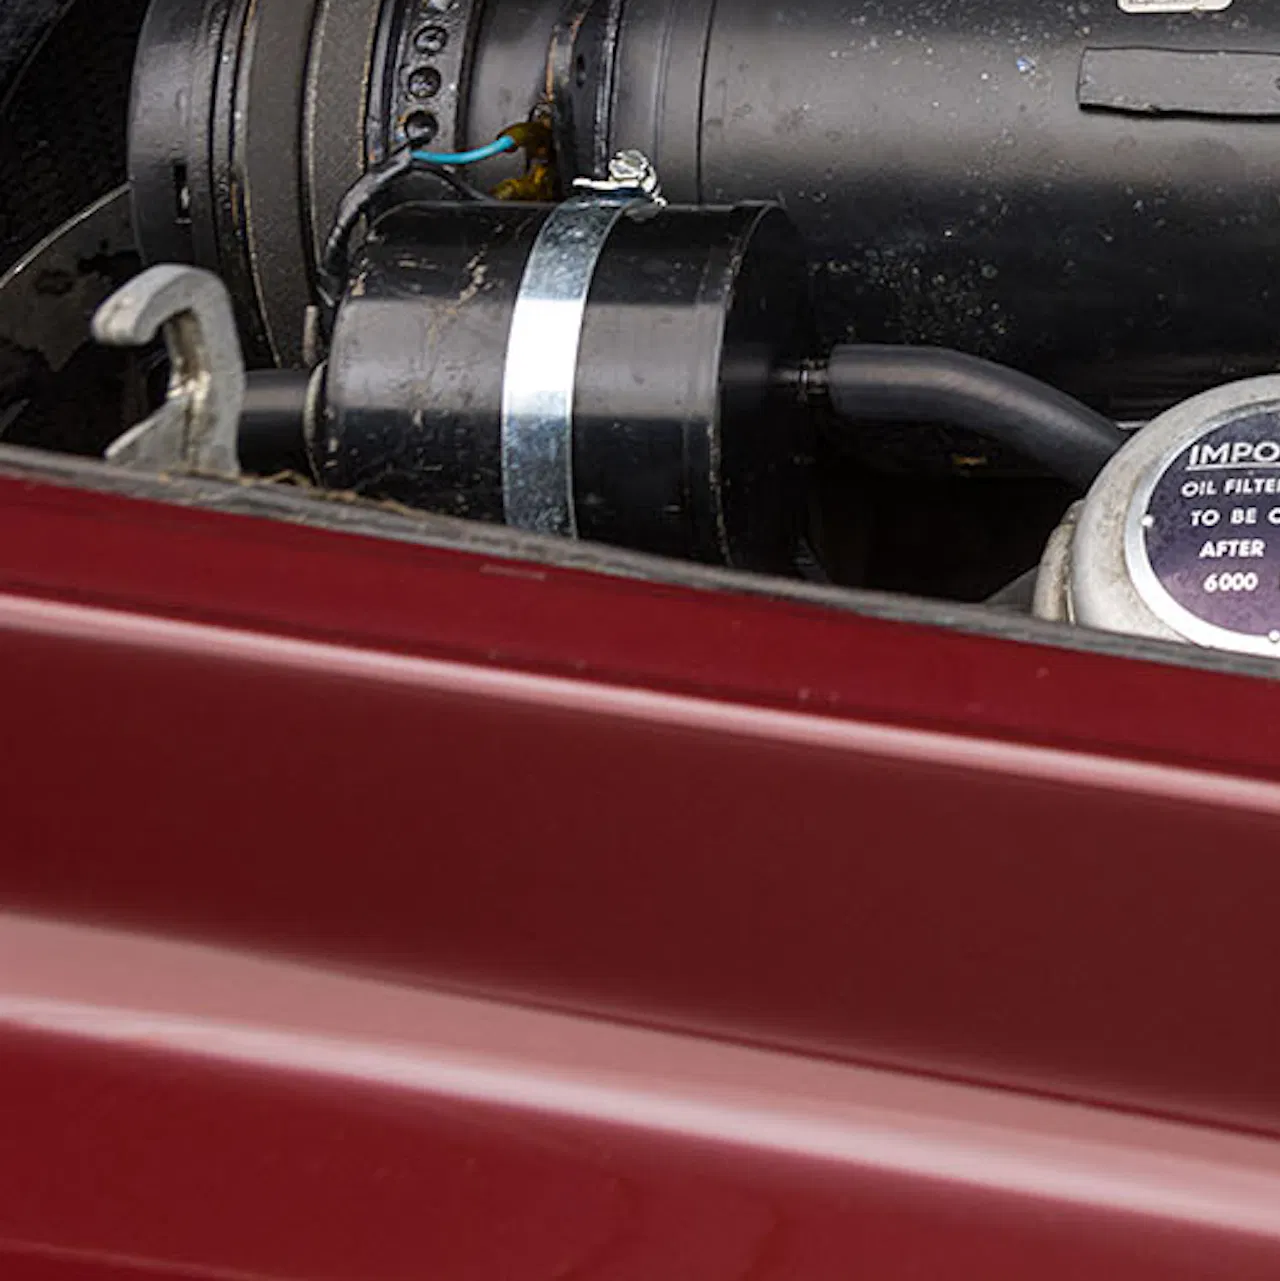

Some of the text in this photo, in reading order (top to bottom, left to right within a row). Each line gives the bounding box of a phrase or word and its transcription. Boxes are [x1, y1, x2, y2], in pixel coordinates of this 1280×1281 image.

[1181, 480, 1218, 498] OIL
[1190, 509, 1221, 528] TO
[1230, 507, 1257, 526] BE
[1199, 539, 1266, 559] AFTER
[1203, 571, 1259, 594] 6000
